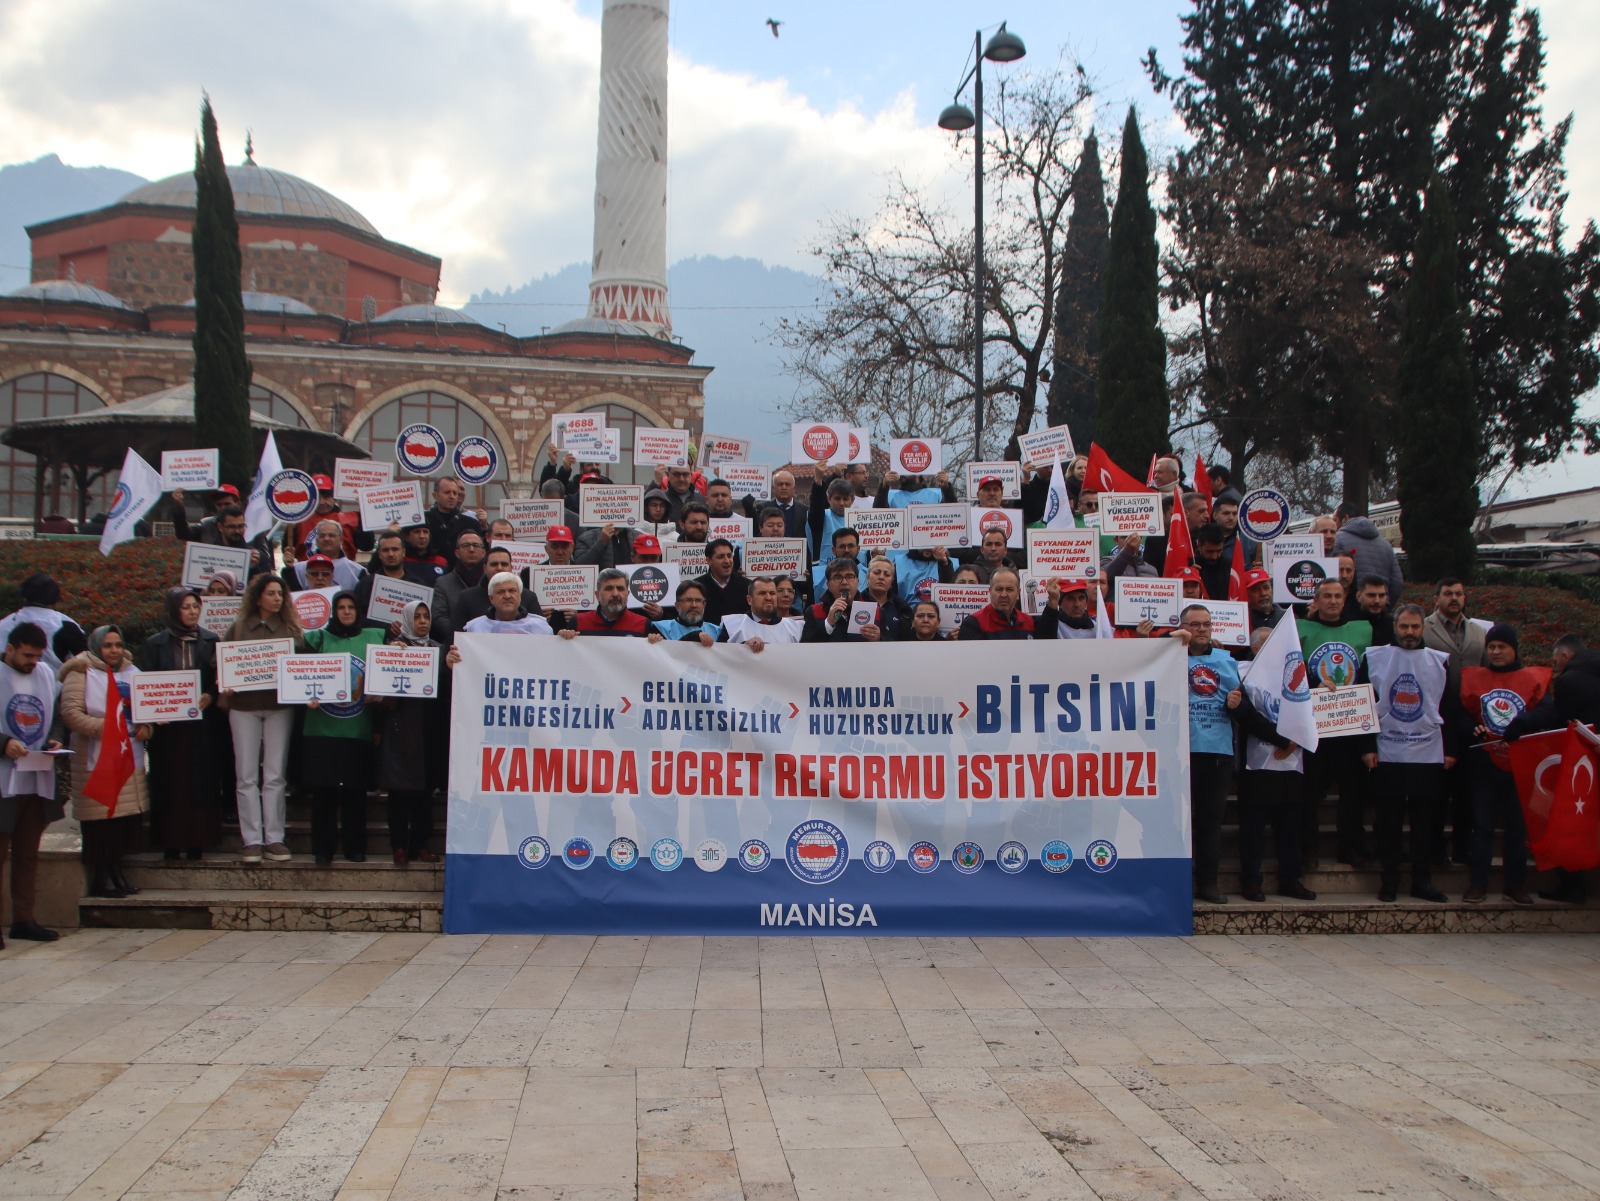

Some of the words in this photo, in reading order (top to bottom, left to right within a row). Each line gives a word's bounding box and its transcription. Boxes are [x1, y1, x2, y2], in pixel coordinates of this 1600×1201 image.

[568, 418, 594, 428] 4688
[458, 439, 477, 452] MEMUR
[716, 442, 740, 451] 4688
[270, 472, 294, 486] MEMUR
[1246, 492, 1269, 505] MEMUR
[857, 513, 896, 521] ENFLASYON
[1107, 506, 1154, 515] YÜKSELİYOR
[713, 525, 740, 533] 4688
[853, 521, 900, 530] YÜKSELİYOR
[751, 562, 796, 571] GERİLİYOR
[544, 576, 585, 584] DURDURUN
[207, 608, 239, 616] DURDUR
[1314, 646, 1328, 660] TOÇ
[484, 673, 571, 700] ÜCRETTE
[643, 678, 723, 704] GELİRDE
[809, 687, 895, 708] KAMUDA
[976, 674, 1156, 734] BİTSİN!
[483, 704, 615, 730] DENGESİZLİK
[1336, 708, 1357, 717] vergide
[642, 708, 781, 734] ADALETSİZLİK
[809, 713, 953, 735] HUZURSUZLUK
[481, 748, 639, 794] KAMUDA
[651, 751, 763, 796] ÜCRET
[775, 753, 945, 799] REFORMU
[958, 752, 1157, 799] İSTİYORUZ!
[792, 823, 842, 841] MEMUR-SEN
[760, 898, 878, 927] MANİSA
